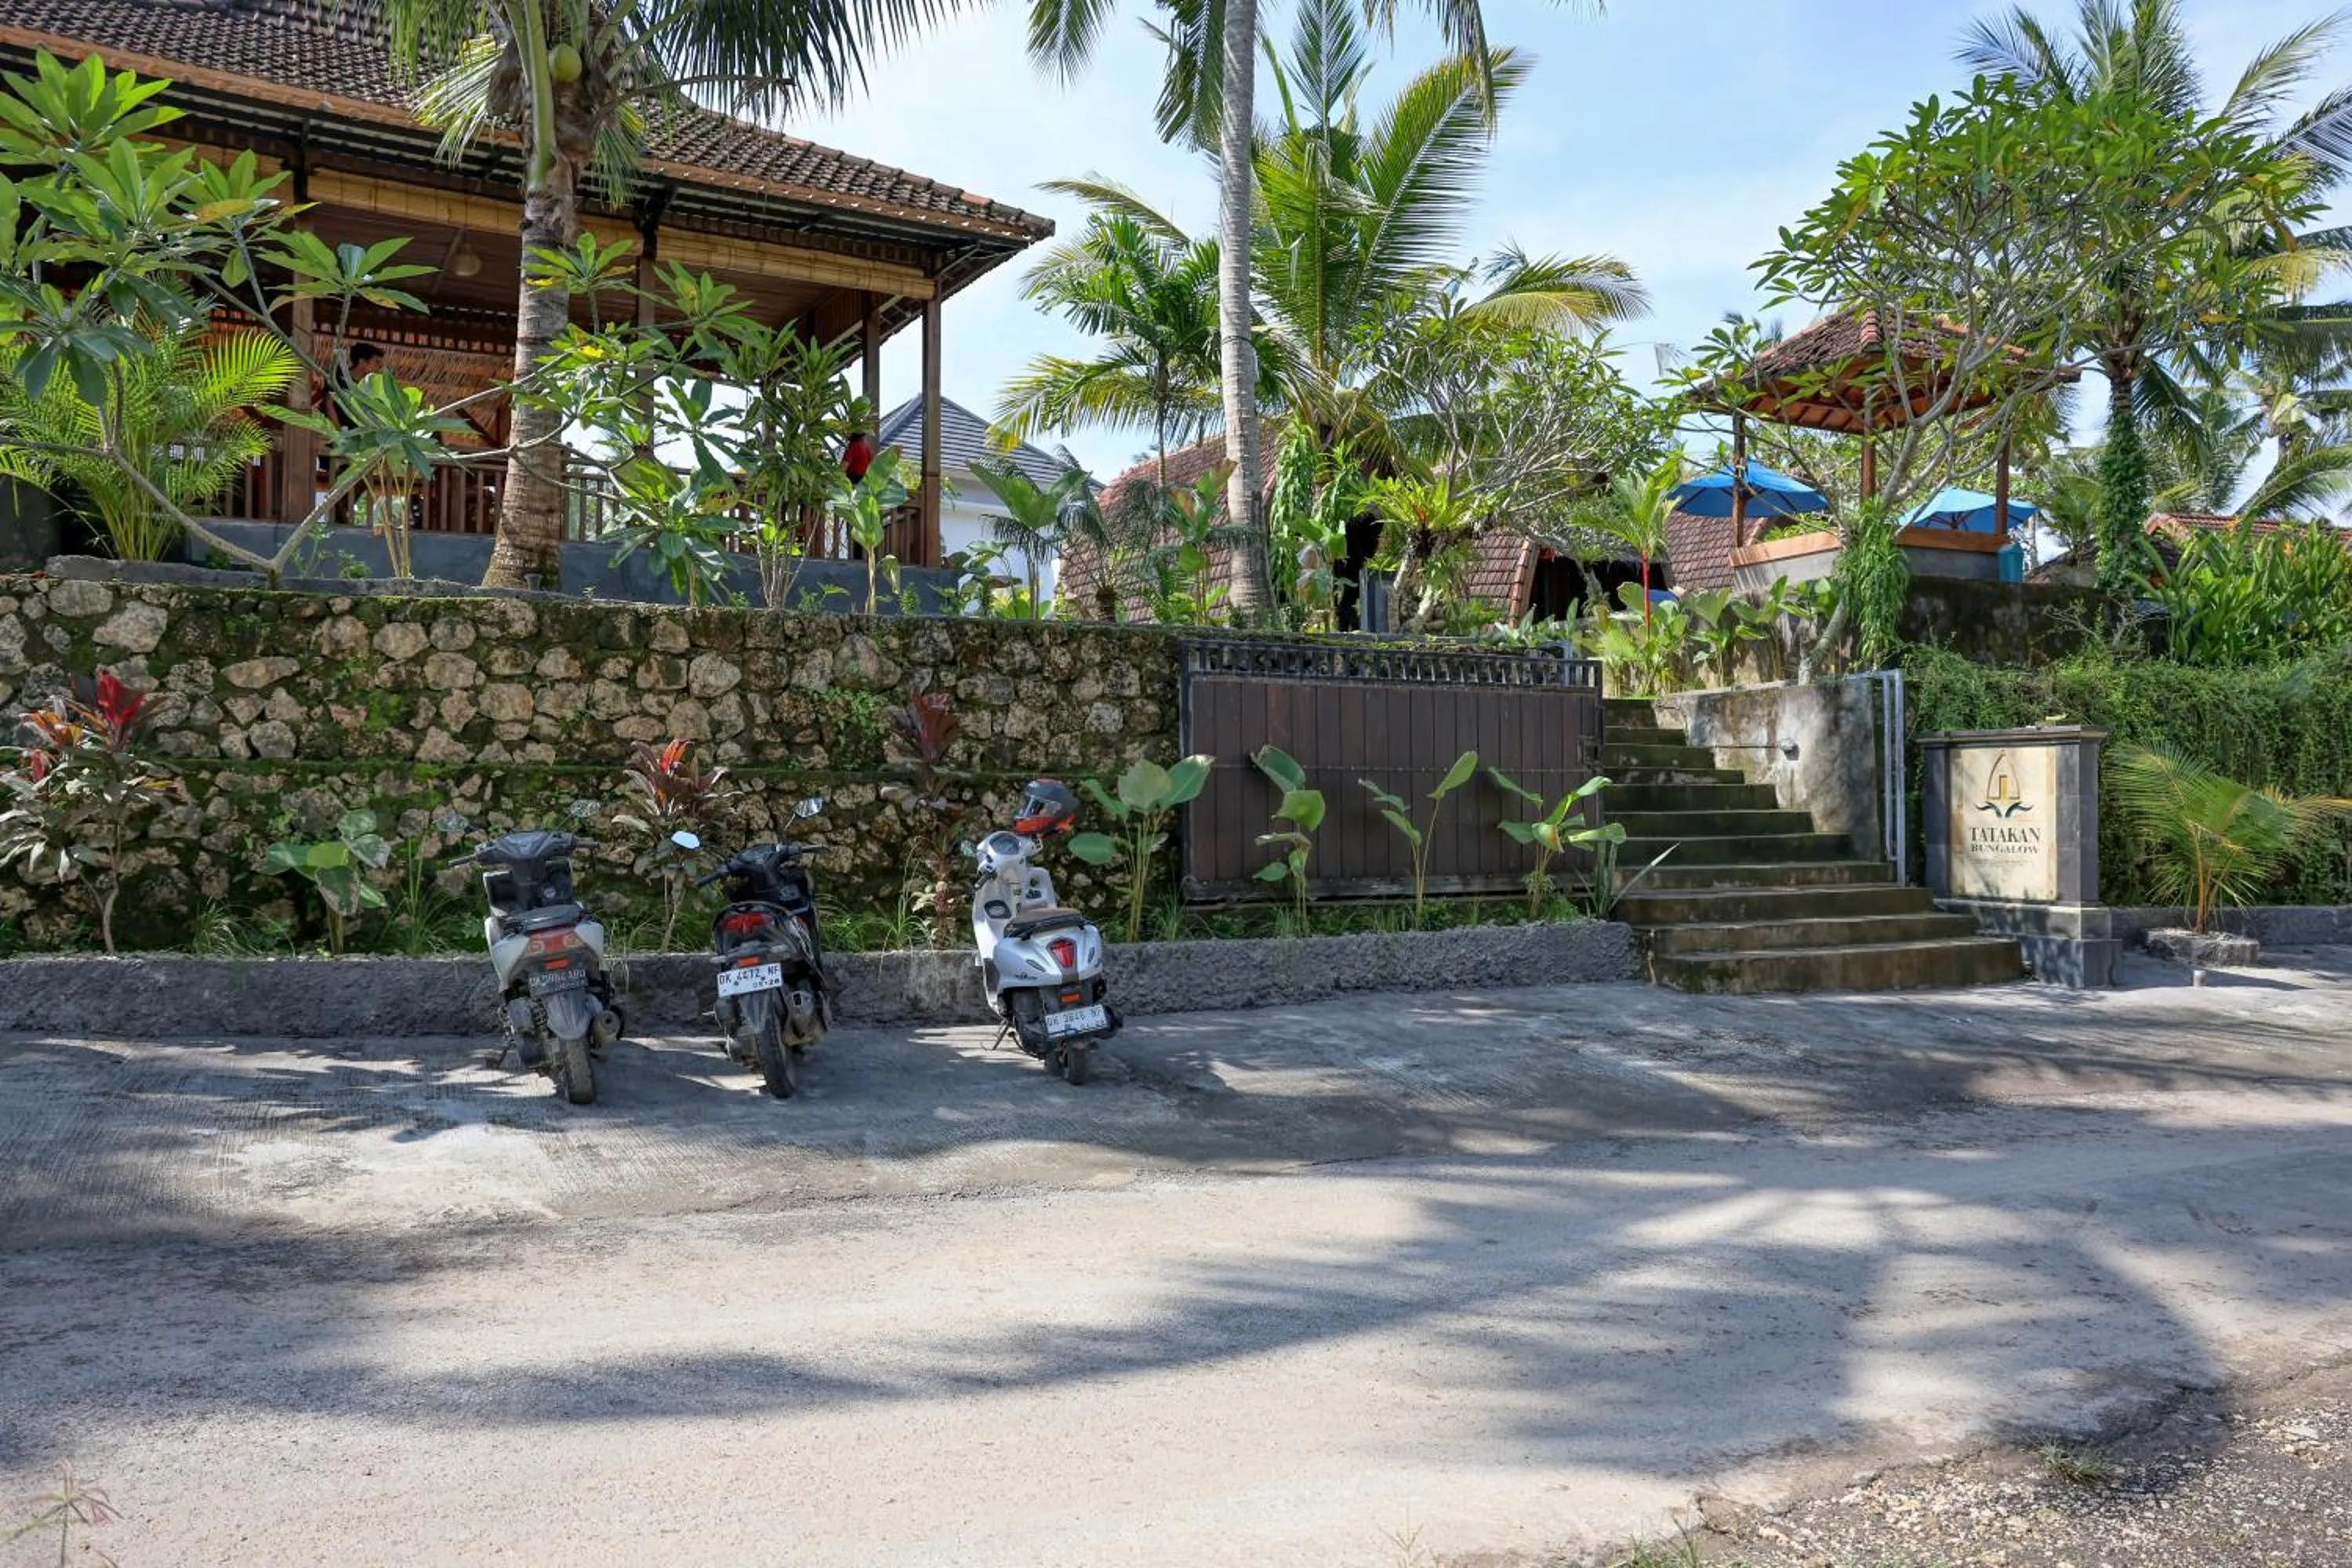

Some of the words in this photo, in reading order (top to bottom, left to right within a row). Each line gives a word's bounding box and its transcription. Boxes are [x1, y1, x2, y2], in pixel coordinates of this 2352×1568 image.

[1969, 827, 2041, 843] TATAKAN
[1971, 844, 2039, 854] BUNGALOW
[719, 974, 731, 985] DK
